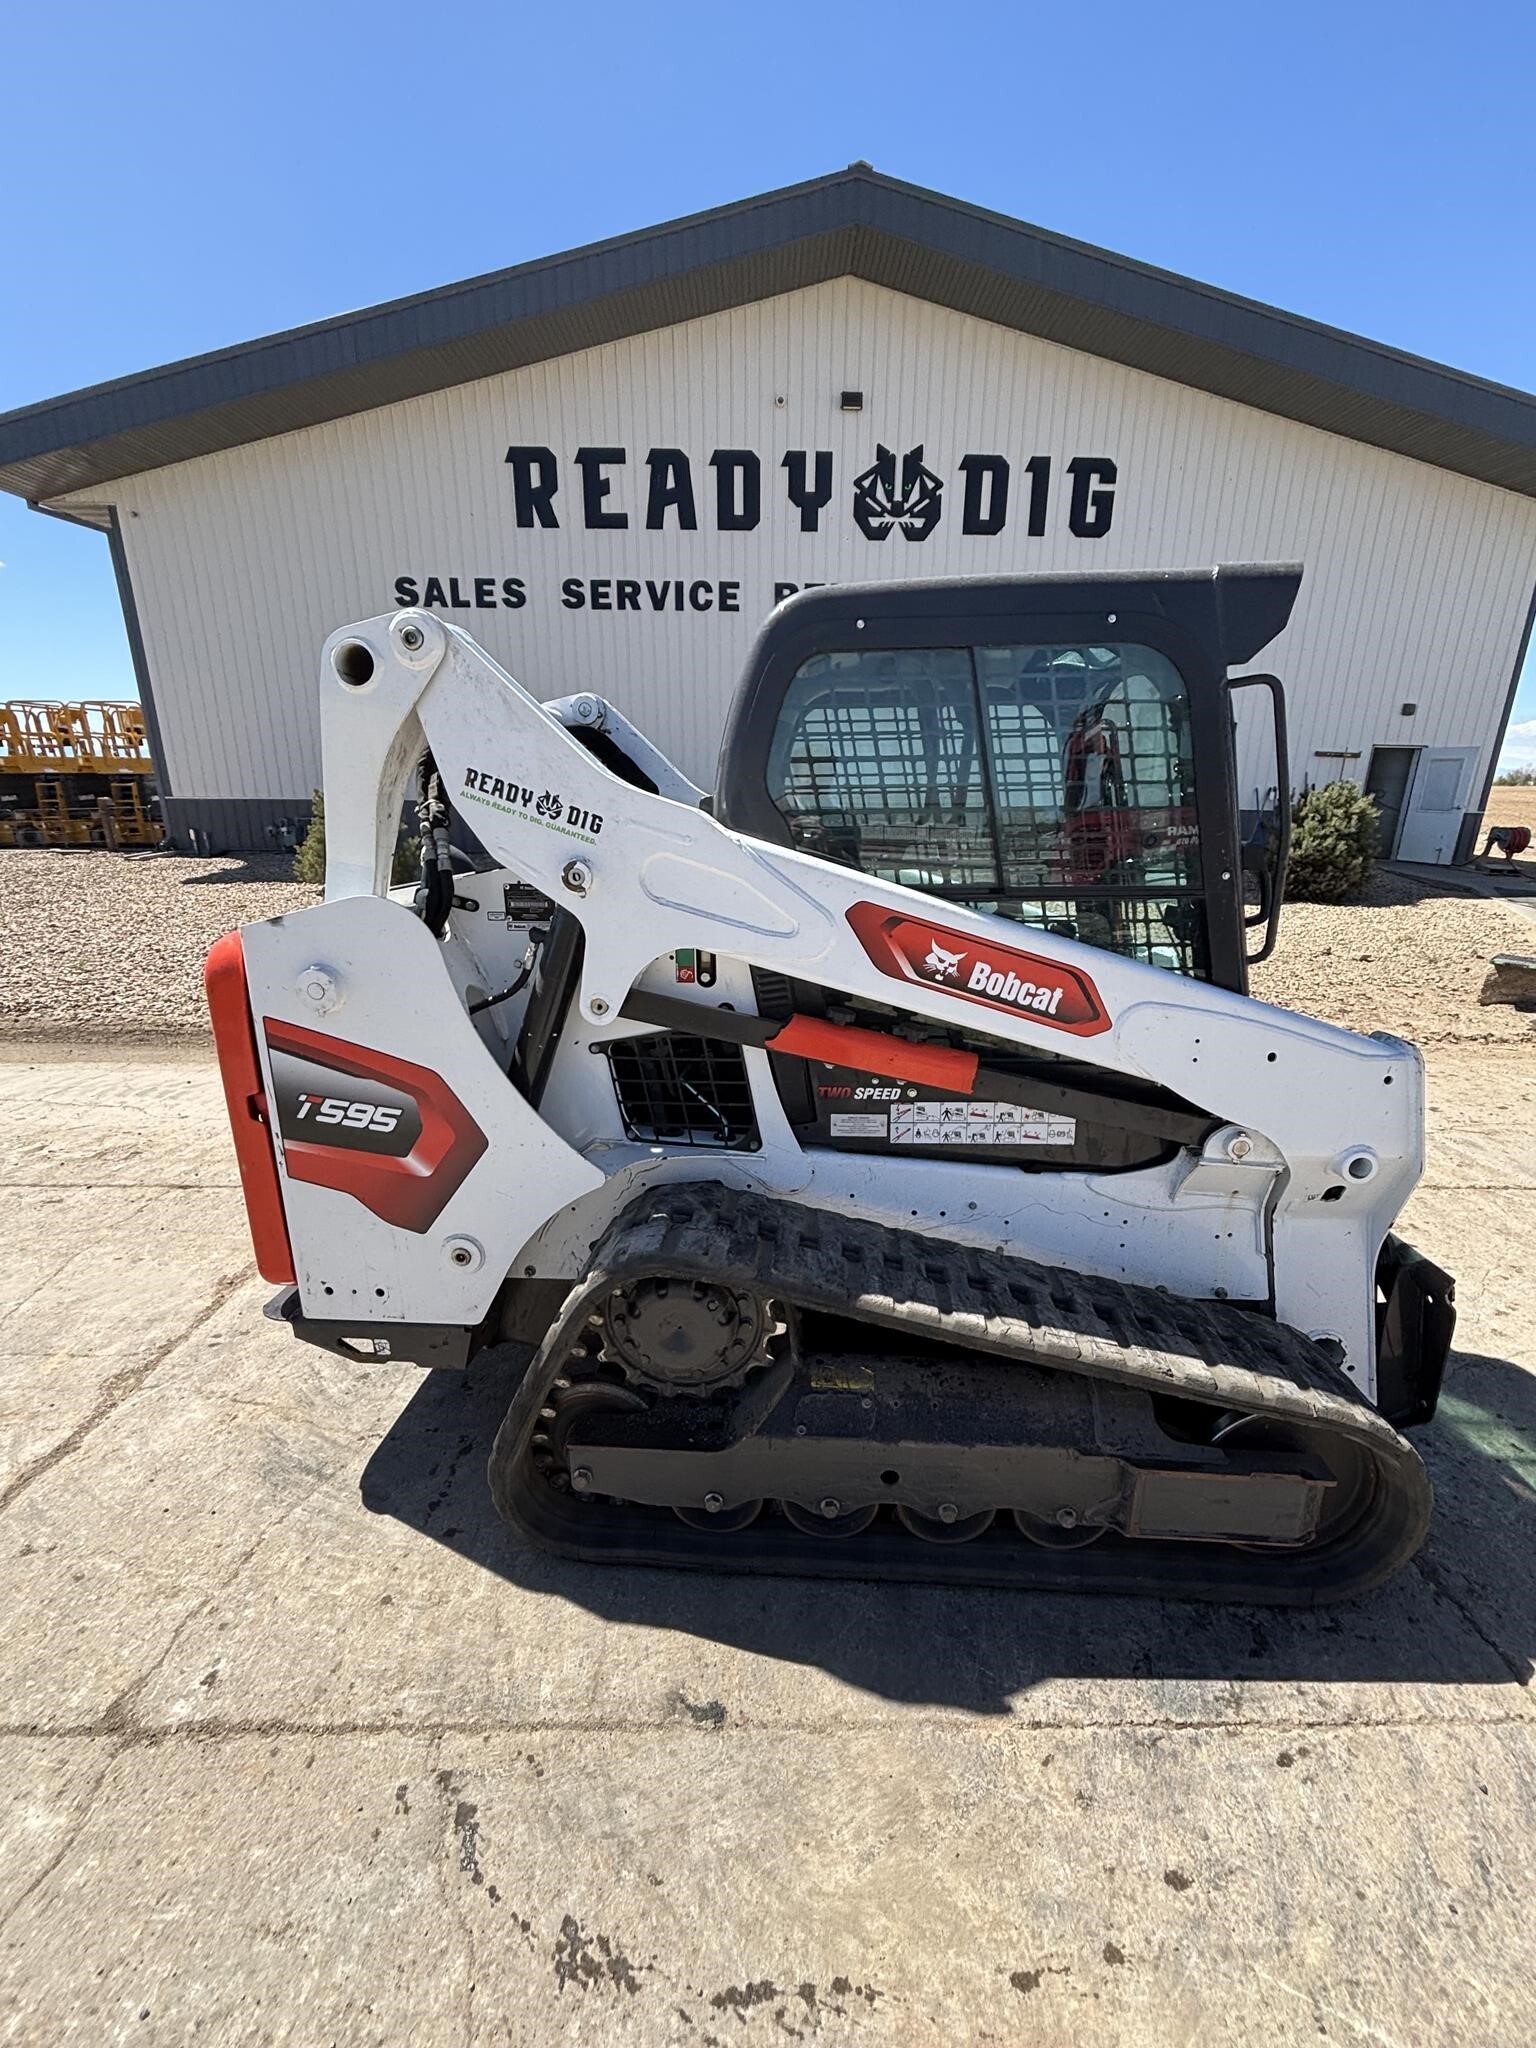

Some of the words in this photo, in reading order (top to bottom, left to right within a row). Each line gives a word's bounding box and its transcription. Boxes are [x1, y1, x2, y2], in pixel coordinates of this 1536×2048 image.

[505, 445, 834, 533] READY
[957, 453, 1118, 539] DIG
[394, 576, 527, 609] SALES
[561, 578, 741, 612] SERVICE
[460, 790, 491, 806] ALWAYS
[491, 801, 516, 816] READY
[518, 811, 529, 820] TO
[464, 767, 534, 808] READY
[566, 805, 604, 835] DIG
[967, 960, 1064, 1015] Bobcat
[818, 1087, 852, 1098] TWO
[854, 1087, 902, 1100] SPEED
[296, 1094, 403, 1133] T595
